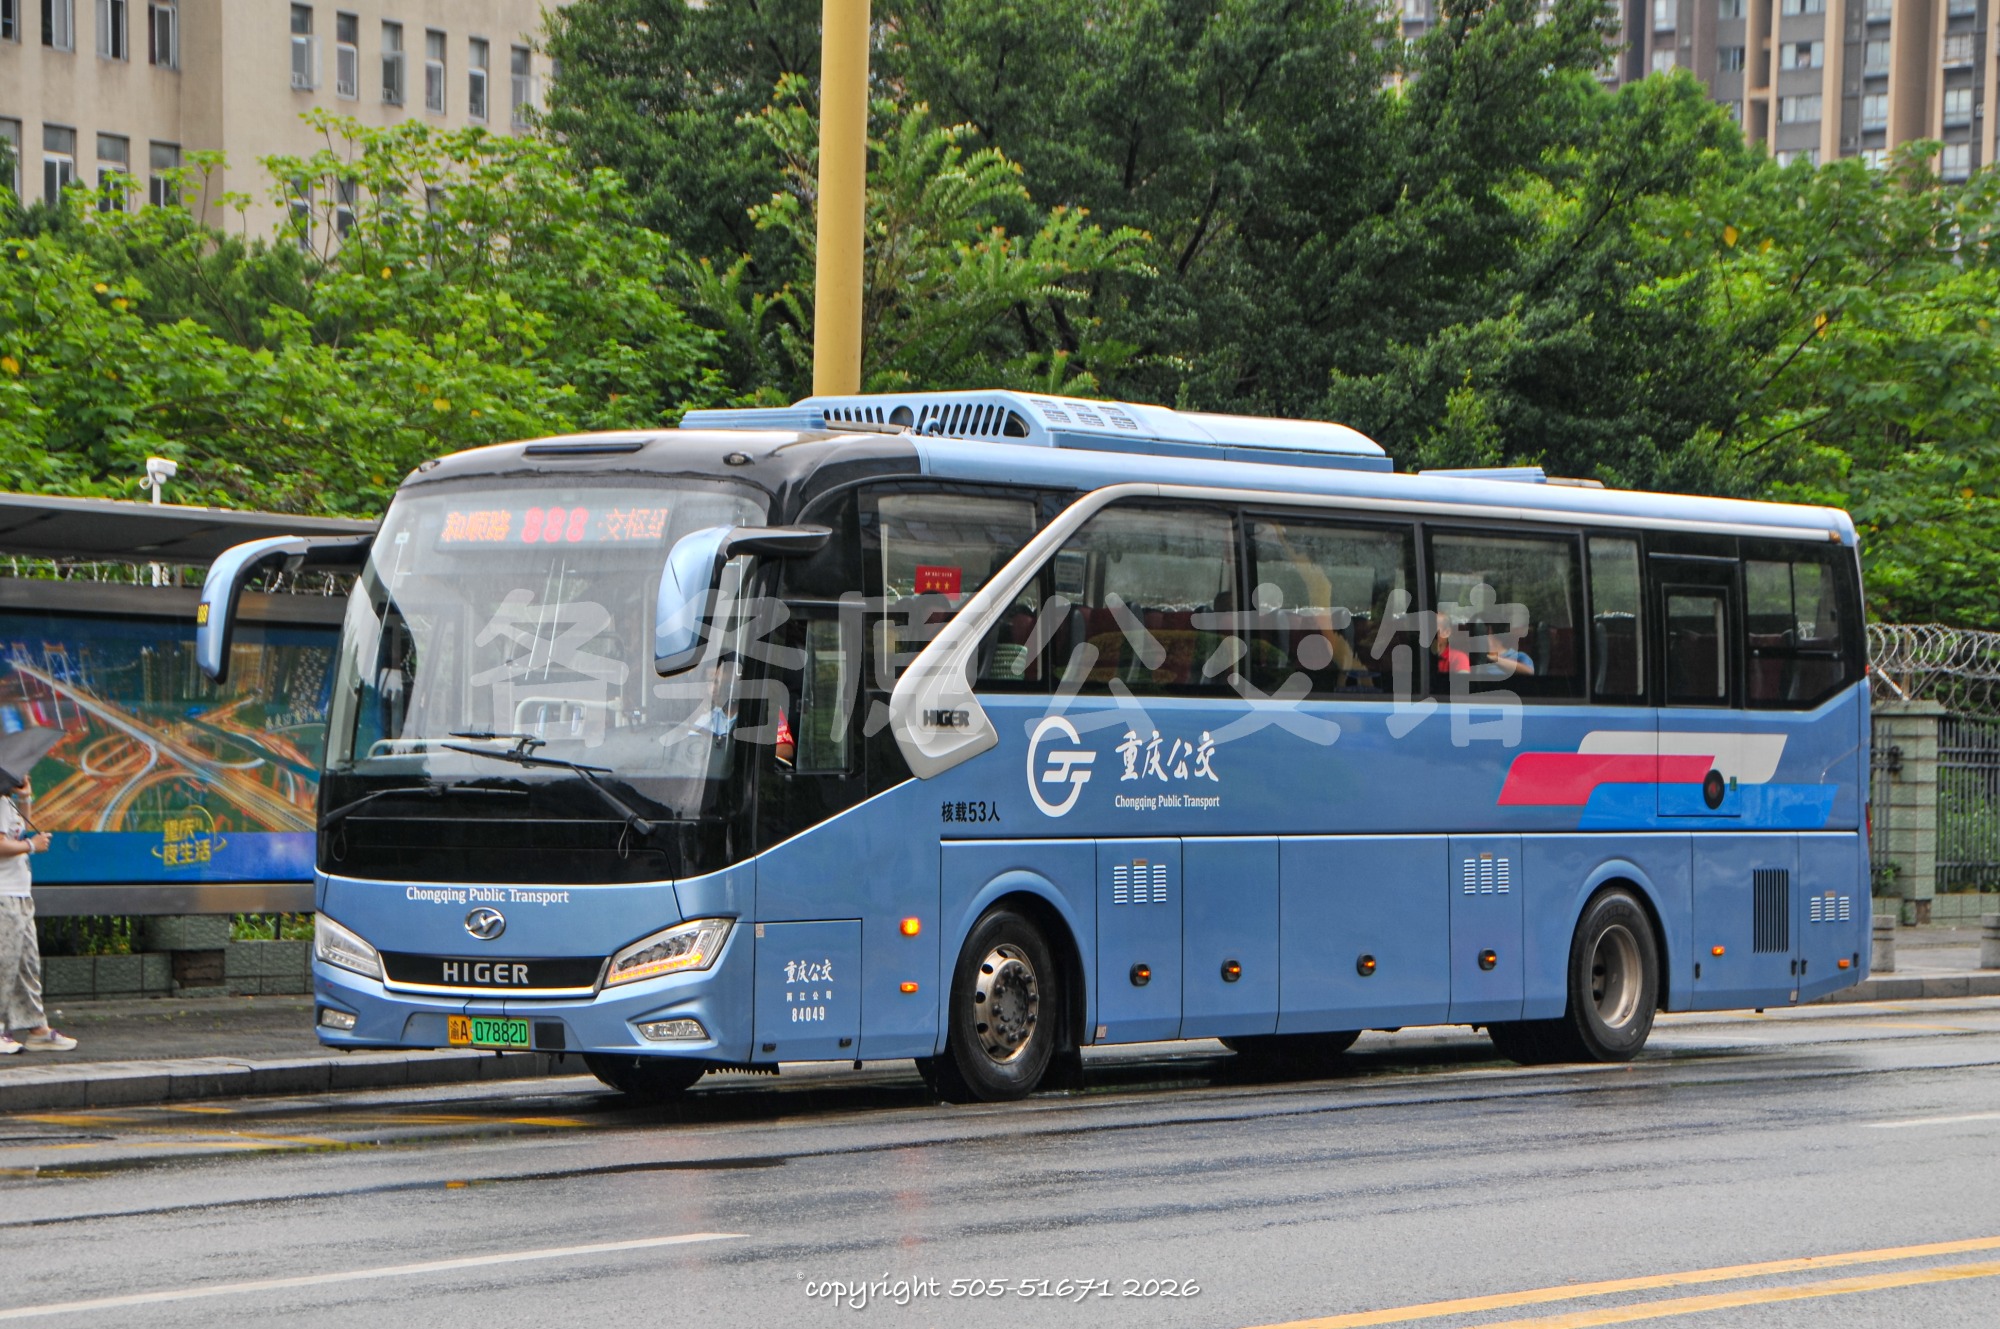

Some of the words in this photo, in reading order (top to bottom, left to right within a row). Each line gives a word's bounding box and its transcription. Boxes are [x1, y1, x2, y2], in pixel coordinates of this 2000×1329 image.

[521, 507, 589, 543] 888
[923, 709, 970, 728] HIGER
[1115, 730, 1219, 782] 重庆公交
[941, 801, 1001, 824] 核载53人
[1115, 795, 1156, 810] Chongqing
[1158, 794, 1181, 808] Public
[1183, 794, 1220, 809] Transport
[163, 839, 211, 867] 夜生活
[406, 886, 466, 904] Chongqing
[469, 887, 506, 903] Public
[510, 889, 569, 906] Transport
[443, 962, 529, 984] HIGER
[784, 959, 833, 984] 重庆公交
[786, 990, 832, 1002] 两江公司
[792, 1006, 825, 1022] 84049
